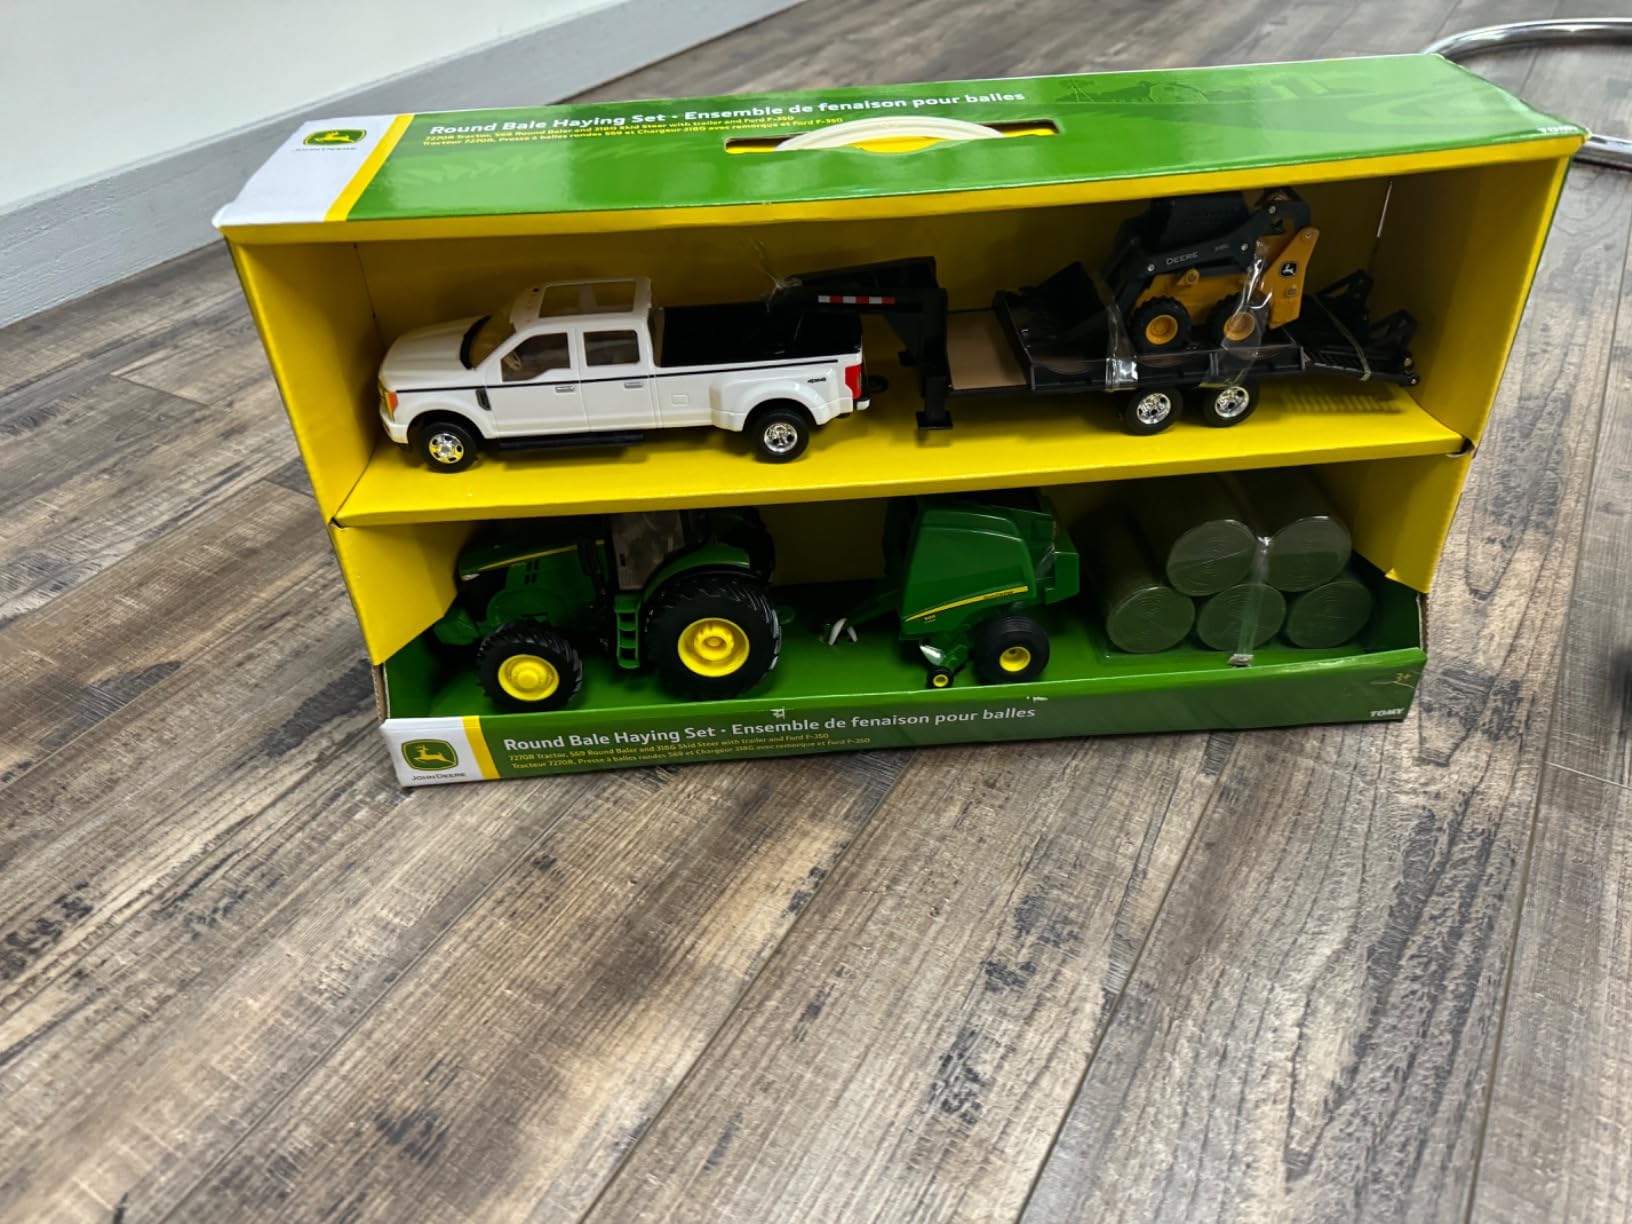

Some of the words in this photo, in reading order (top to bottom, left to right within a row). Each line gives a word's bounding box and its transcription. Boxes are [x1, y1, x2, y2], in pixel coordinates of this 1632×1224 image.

[430, 123, 498, 134] Round
[502, 120, 547, 130] Bale
[553, 117, 626, 128] Haying
[631, 114, 666, 123] Set
[684, 107, 783, 120] Ensemble
[789, 105, 813, 113] de
[818, 99, 907, 112] fenaison
[913, 95, 960, 108] pour
[964, 92, 1025, 103] balles
[1166, 251, 1199, 265] DEERE
[503, 735, 565, 750] Round
[568, 733, 610, 746] Bale
[613, 730, 680, 745] Haying
[684, 727, 716, 739] Set
[732, 719, 820, 735] Ensemble
[824, 717, 847, 729] de
[851, 714, 929, 727] fenaison
[935, 712, 978, 726] pour
[982, 707, 1036, 720] balles
